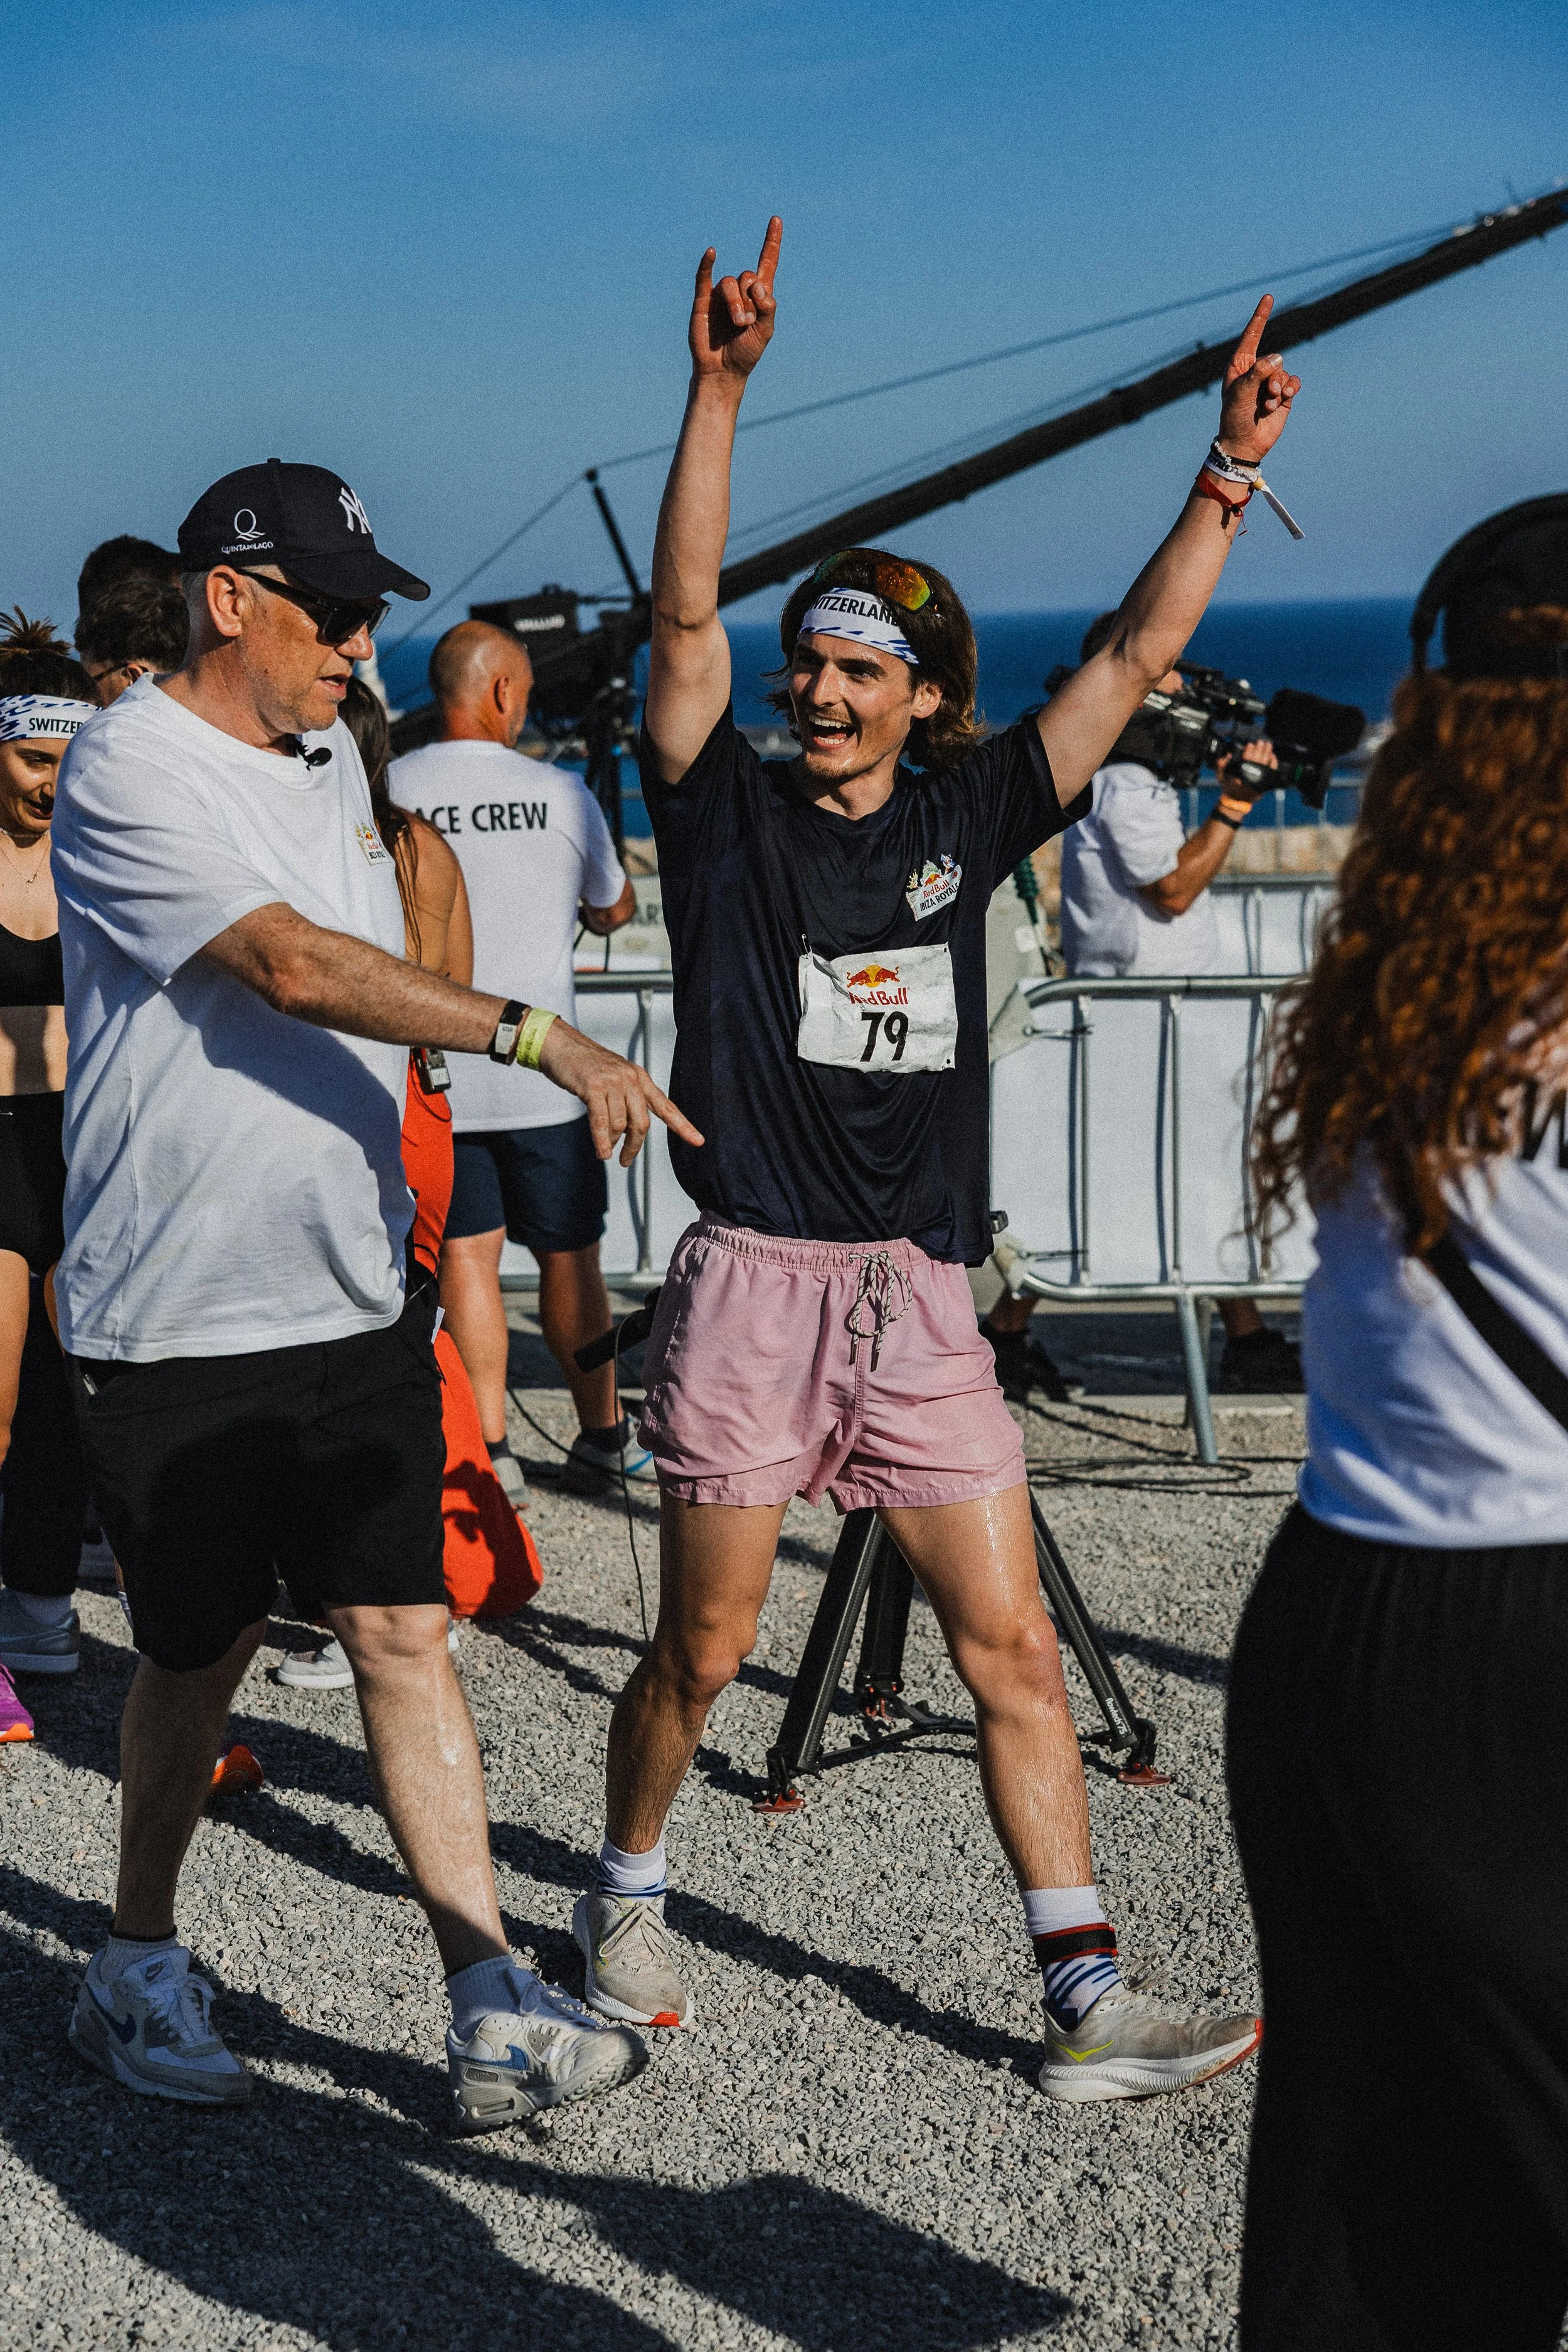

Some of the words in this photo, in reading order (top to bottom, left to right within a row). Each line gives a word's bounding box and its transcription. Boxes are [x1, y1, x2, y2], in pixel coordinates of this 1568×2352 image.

[472, 802, 547, 832] CREW
[919, 898, 936, 911] IBIZA
[935, 882, 958, 903] ROYALE
[860, 1011, 909, 1062] 79
